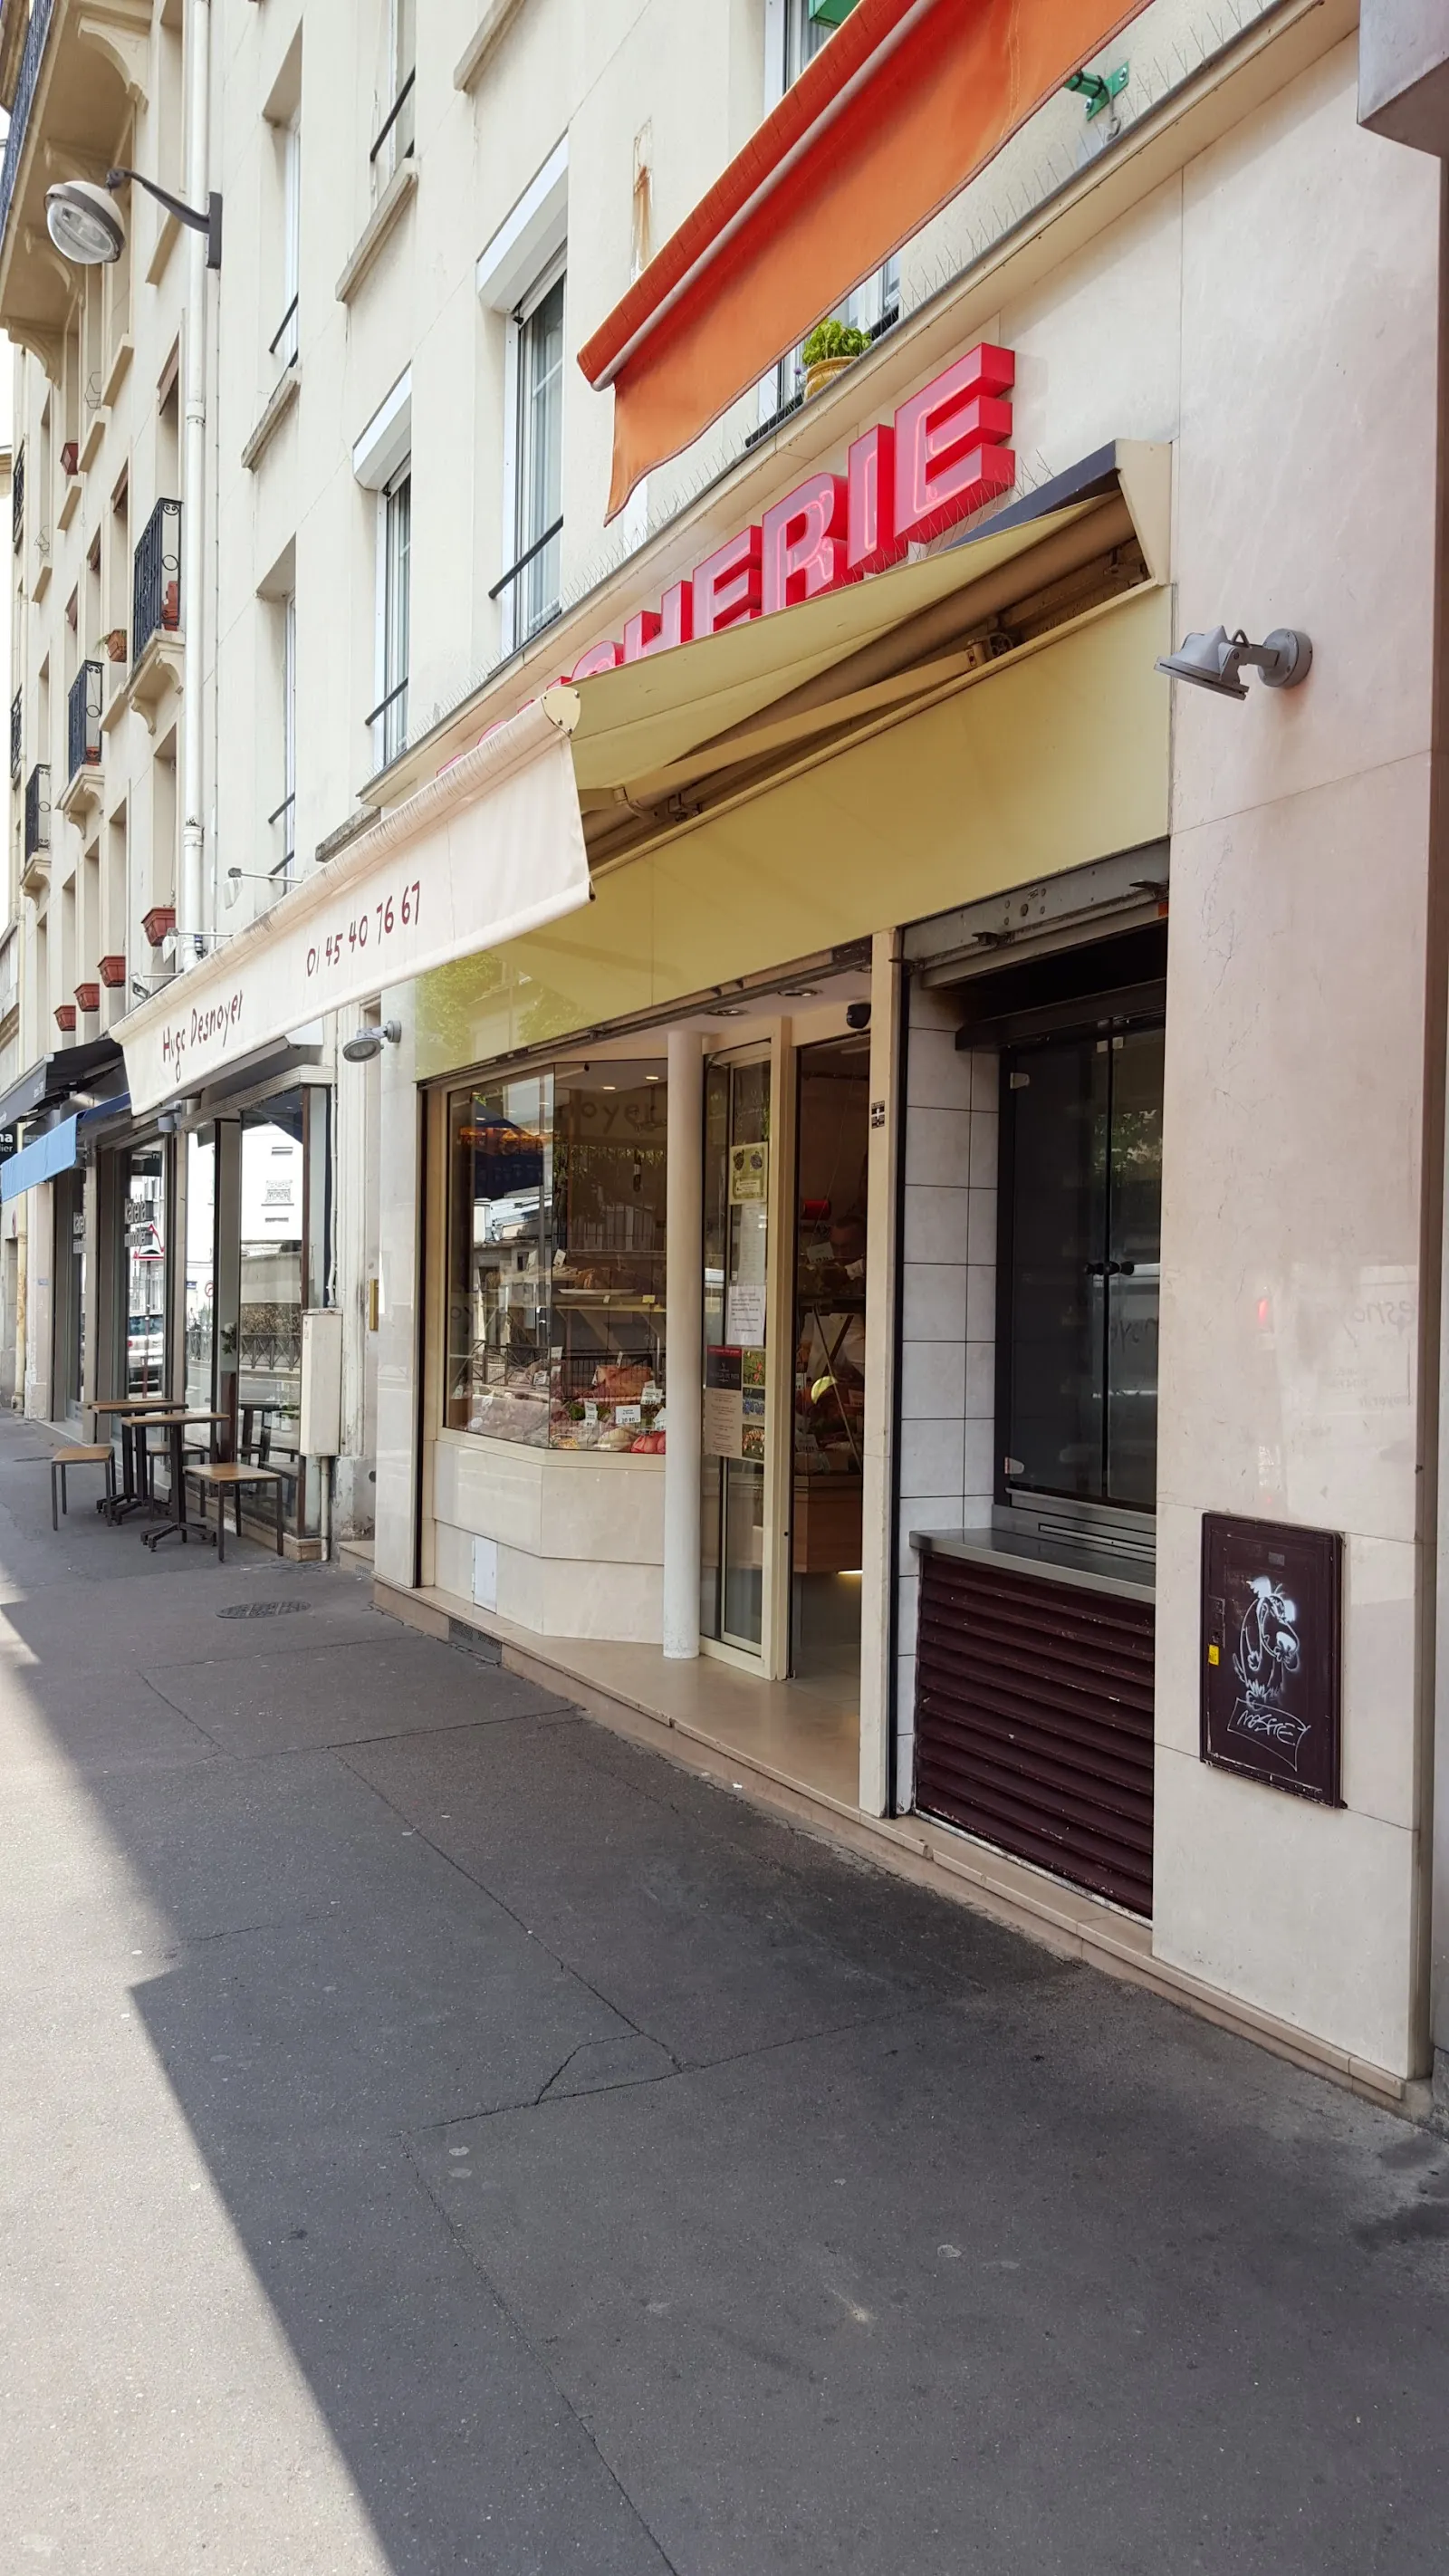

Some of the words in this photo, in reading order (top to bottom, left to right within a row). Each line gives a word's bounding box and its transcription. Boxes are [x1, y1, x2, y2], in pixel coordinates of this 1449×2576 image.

[307, 946, 321, 977] 01
[326, 933, 343, 966] 45
[349, 915, 368, 953] 40
[376, 895, 394, 945] 76
[401, 880, 420, 926] 67
